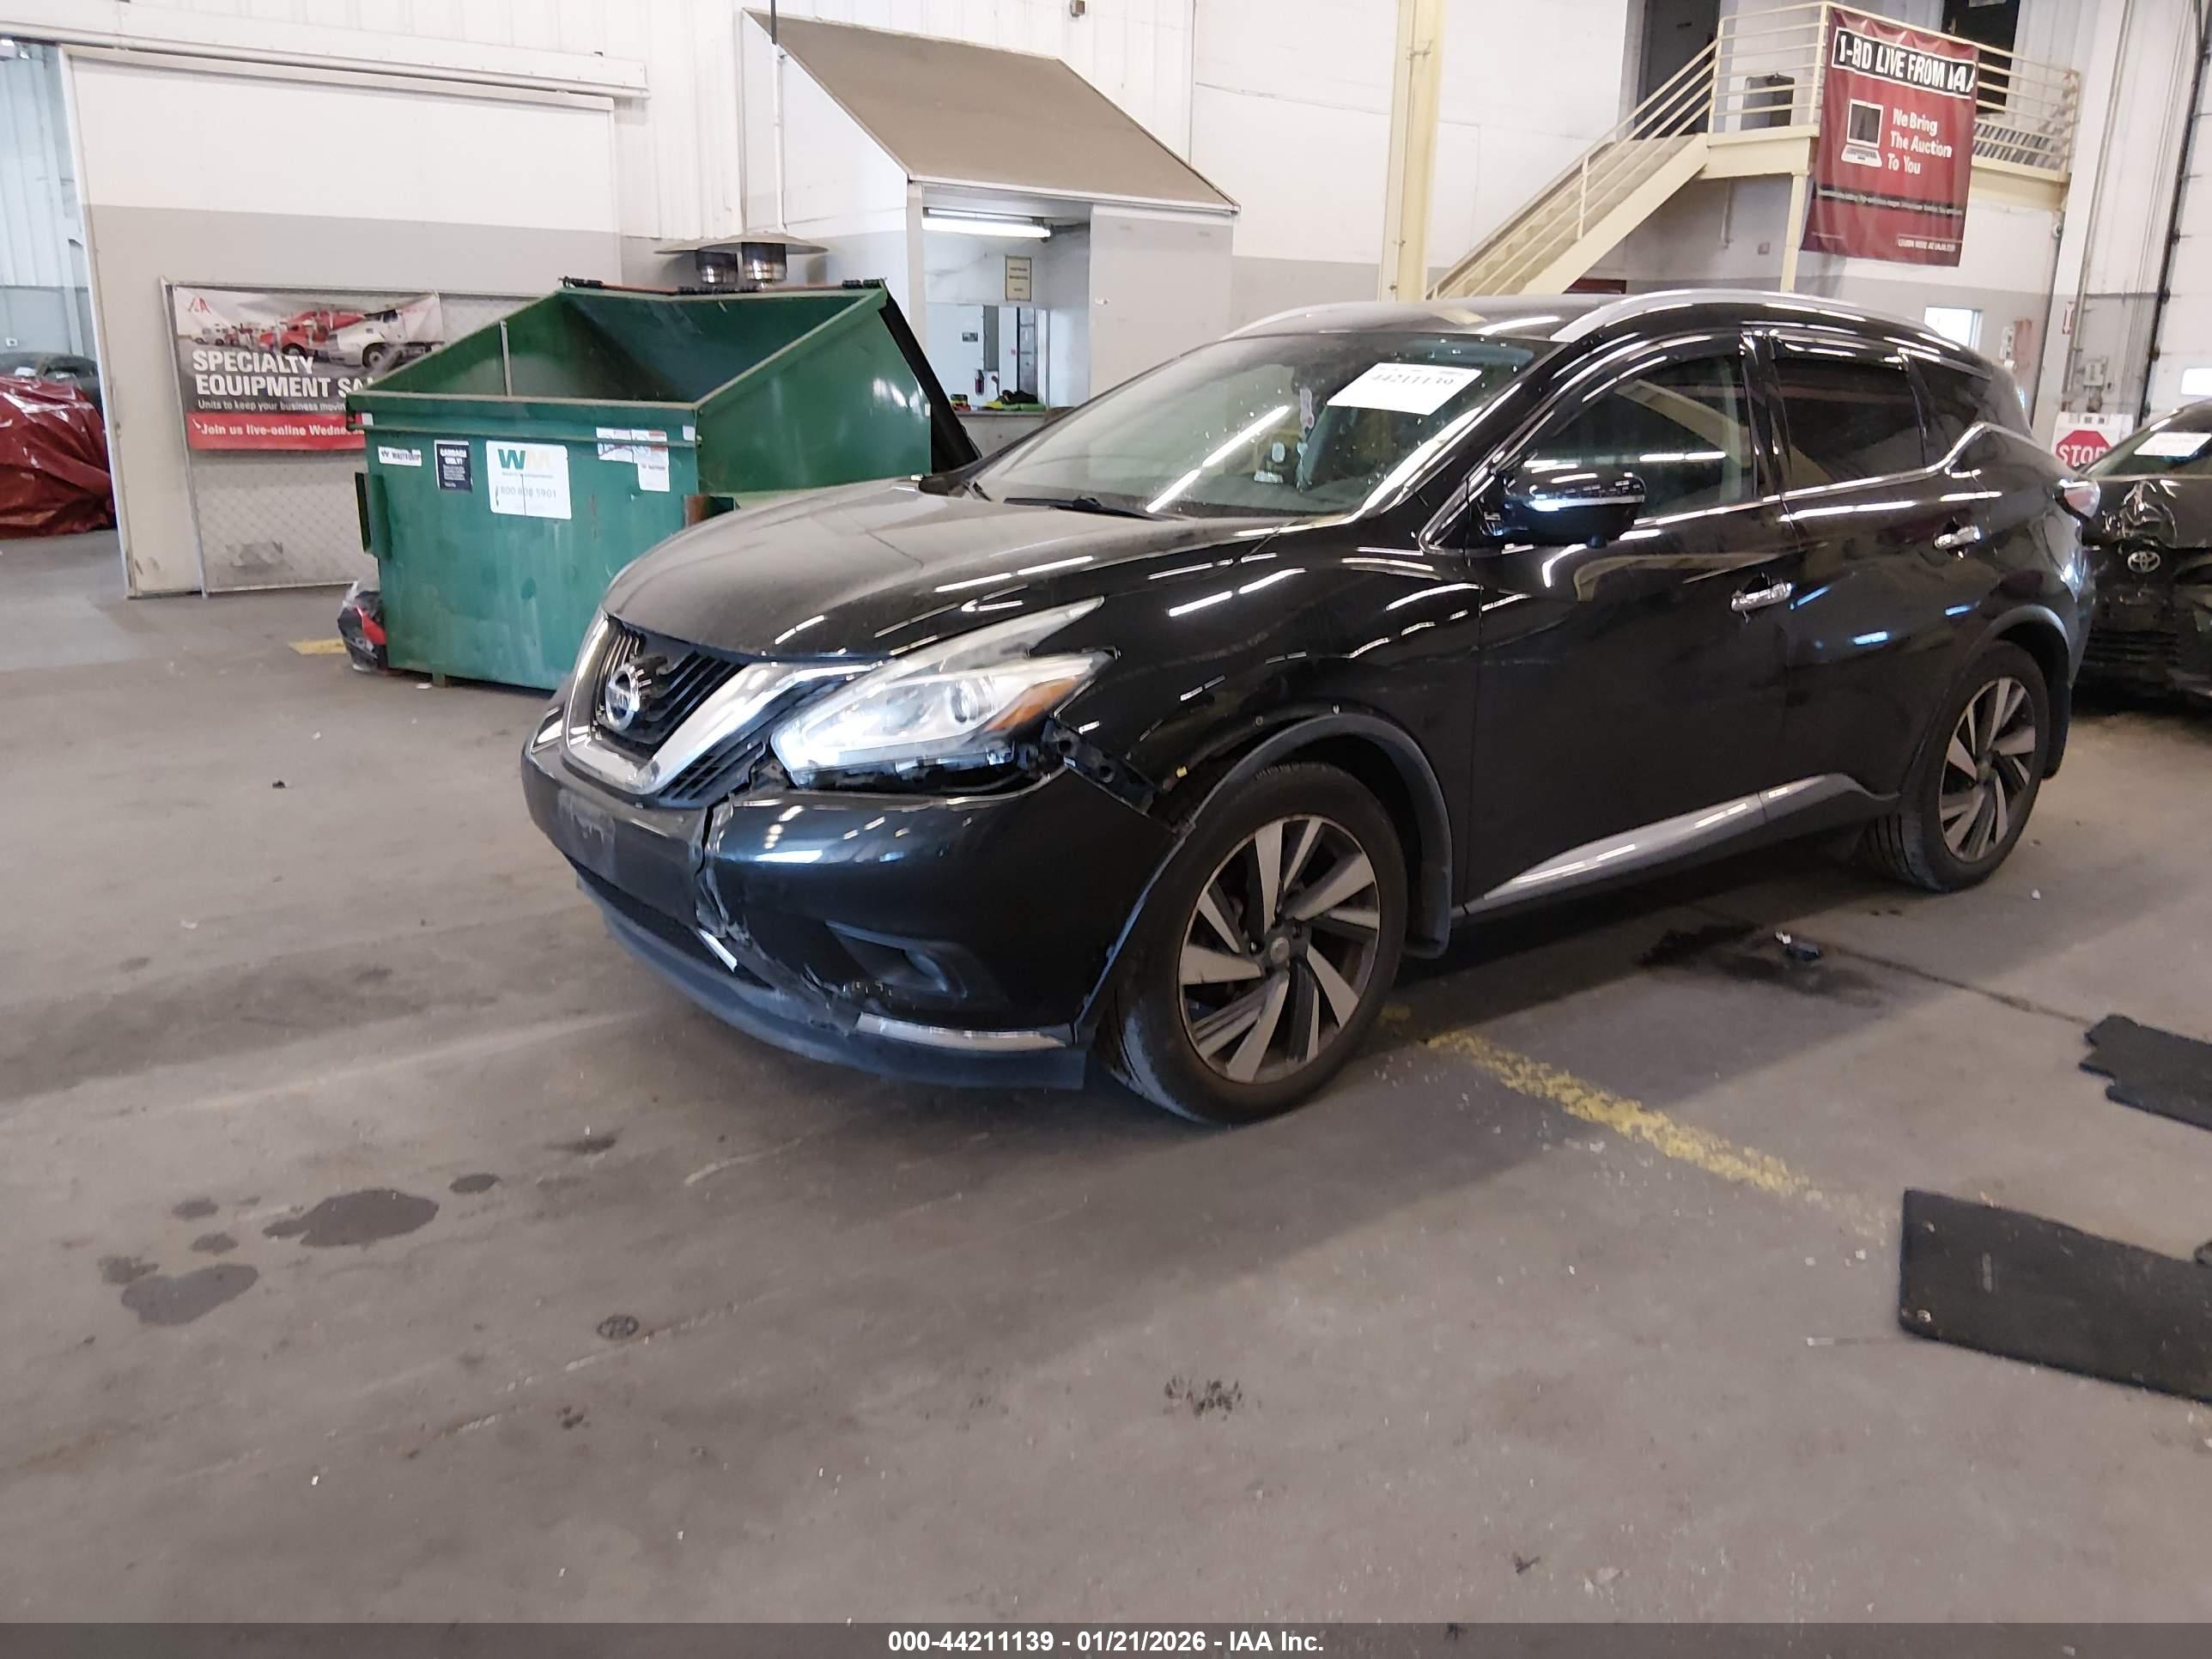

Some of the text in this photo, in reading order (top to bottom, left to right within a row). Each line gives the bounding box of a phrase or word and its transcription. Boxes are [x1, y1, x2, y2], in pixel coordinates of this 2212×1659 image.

[1875, 45, 1906, 79] LIVE
[1907, 53, 1946, 88] FROM
[1909, 111, 1938, 137] Bring
[1890, 130, 1953, 158] The Auction
[1887, 152, 1921, 175] To You
[191, 349, 314, 374] SPECIALTY
[195, 374, 374, 398] EQUIPMENT SA
[198, 398, 346, 412] Units to keep your business movin
[201, 423, 365, 436] Join us live-online Wedne
